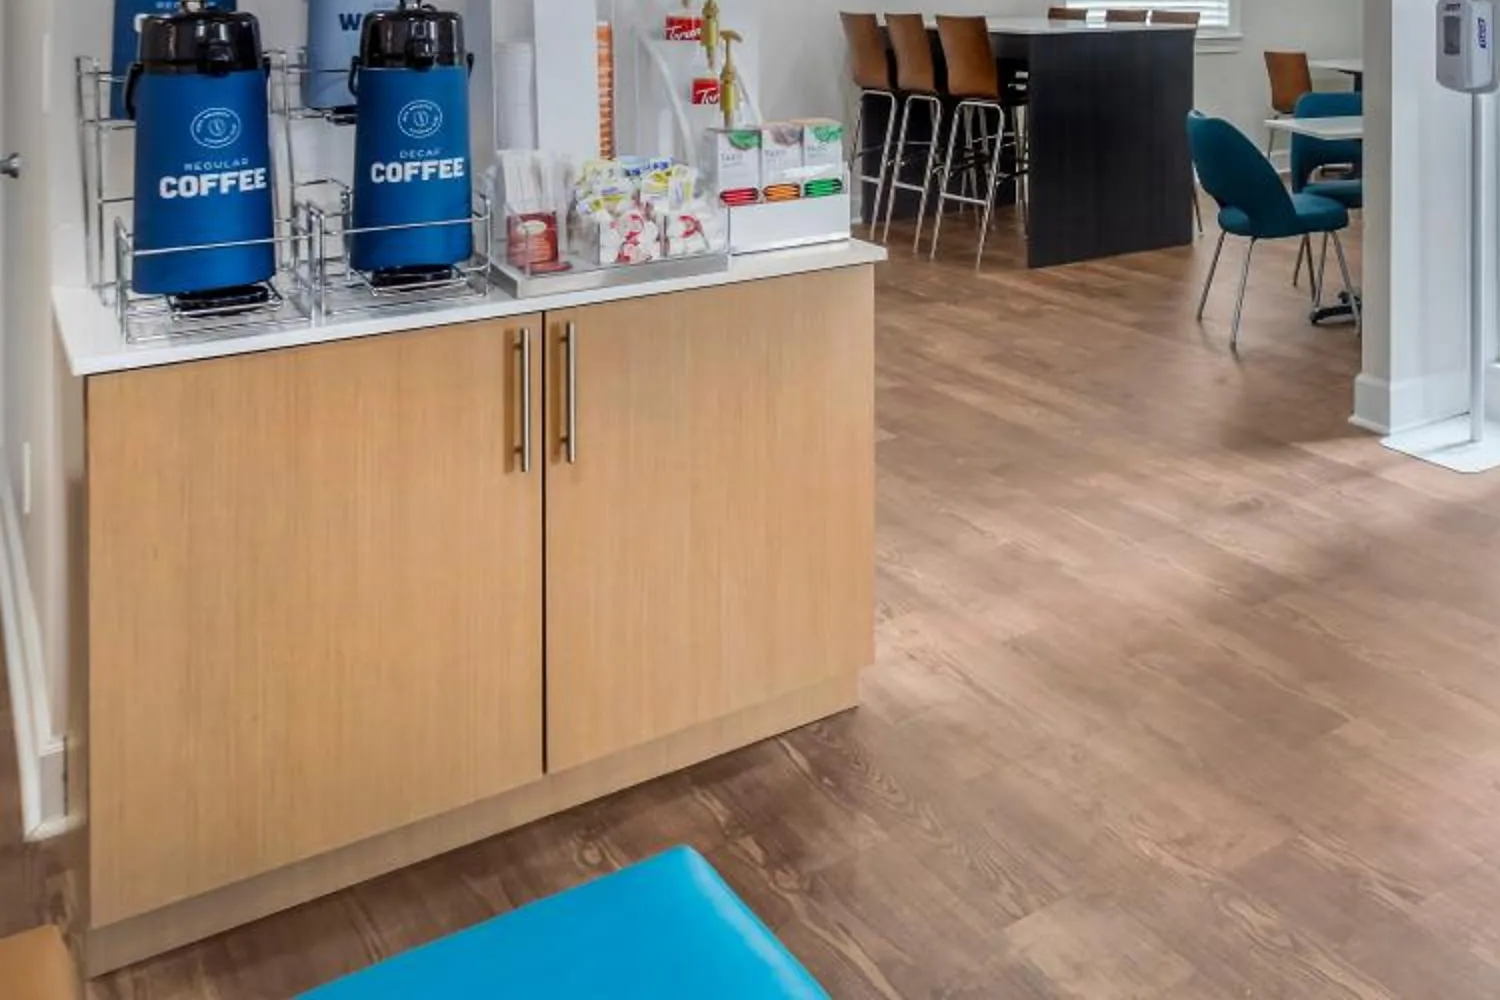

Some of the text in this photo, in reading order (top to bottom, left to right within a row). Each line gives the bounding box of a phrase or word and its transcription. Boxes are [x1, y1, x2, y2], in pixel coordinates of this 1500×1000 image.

[183, 157, 249, 172] REGULAR
[371, 157, 465, 184] COFFEE
[159, 166, 267, 200] COFFEE
